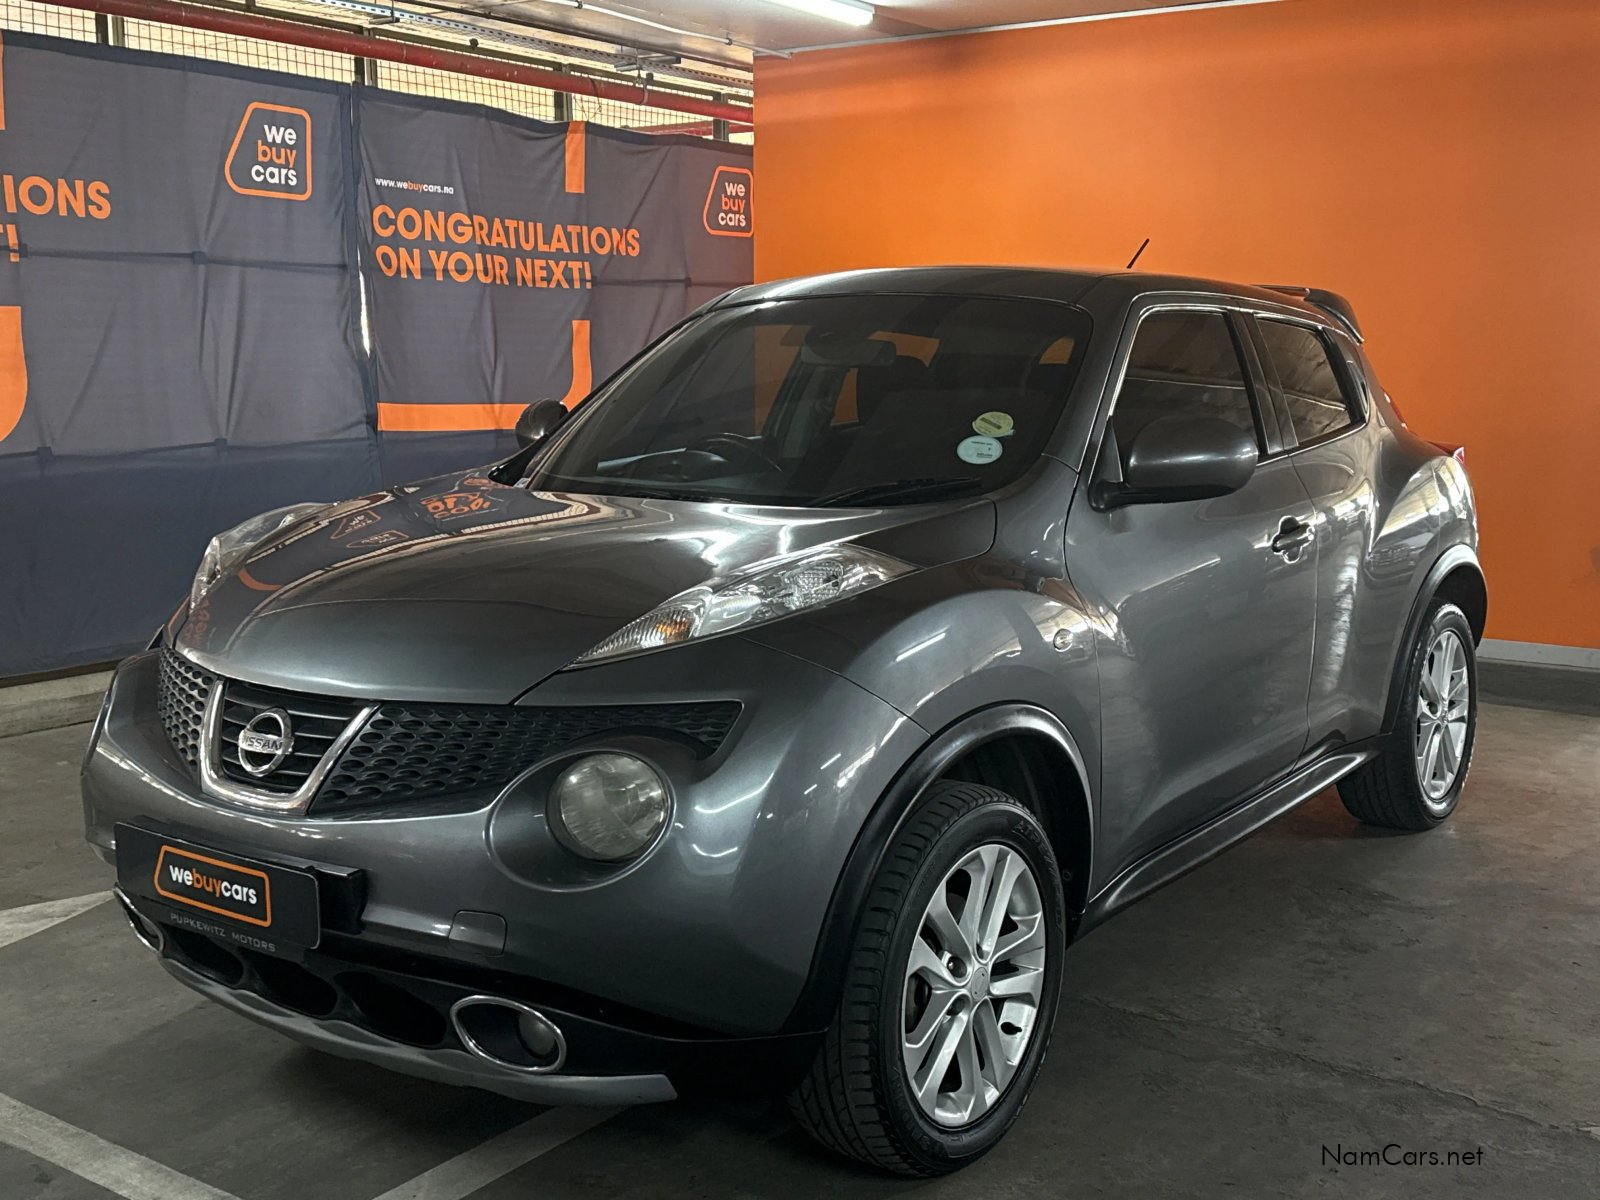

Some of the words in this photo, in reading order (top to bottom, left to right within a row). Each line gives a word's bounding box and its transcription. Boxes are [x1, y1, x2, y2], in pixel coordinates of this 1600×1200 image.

[264, 124, 297, 145] we
[257, 140, 296, 168] buy
[251, 165, 297, 186] cars
[375, 177, 454, 195] www.webuycars.na
[725, 181, 745, 197] we
[721, 194, 745, 213] buy
[718, 211, 746, 227] cars
[372, 204, 640, 257] CONGRATULATIONS
[375, 245, 421, 280] ON
[429, 250, 509, 286] YOUR
[515, 257, 592, 290] NEXT!
[169, 864, 257, 905] webuycars
[170, 912, 226, 937] PUPKEWITZ
[232, 932, 276, 952] MOTORS
